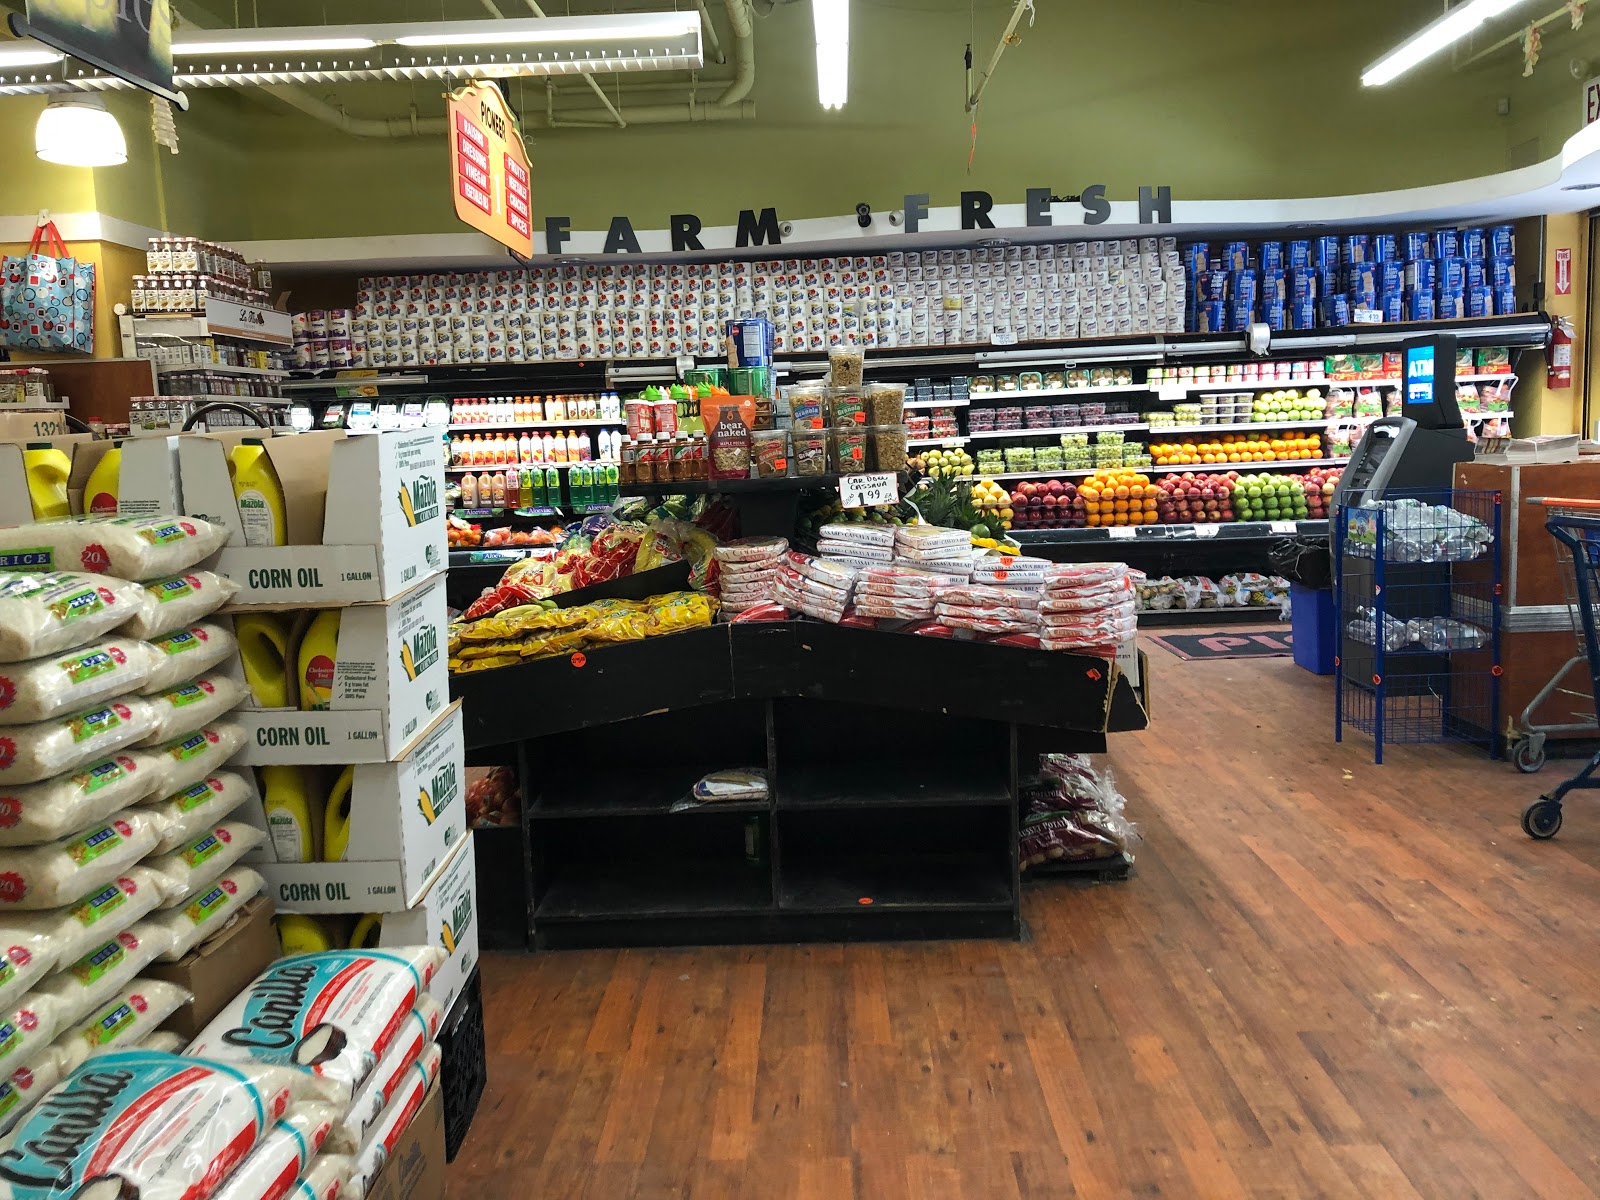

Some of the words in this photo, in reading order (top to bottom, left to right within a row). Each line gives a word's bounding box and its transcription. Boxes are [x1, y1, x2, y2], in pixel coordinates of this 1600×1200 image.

[480, 101, 506, 142] PIONEER
[463, 118, 484, 148] RAISINS
[462, 142, 487, 171] DRESSING
[464, 161, 487, 189] VINEGAR
[507, 156, 526, 183] FRUITS
[494, 173, 502, 215] 1
[510, 212, 528, 235] SPICES
[545, 207, 782, 255] FARM
[904, 184, 1172, 233] FRESH
[1557, 252, 1569, 260] FIRE
[1408, 358, 1434, 379] ATM
[794, 405, 820, 418] Granola
[836, 404, 861, 417] Granola
[717, 429, 747, 438] naked
[719, 421, 743, 430] bear
[758, 449, 783, 462] Granola
[240, 497, 265, 509] Mazola
[412, 474, 438, 512] Mazola
[84, 550, 101, 564] 20
[925, 560, 951, 568] CASSAVA
[951, 561, 972, 569] BREAD
[249, 568, 293, 589] CORN
[297, 567, 324, 588] OIL
[346, 571, 372, 581] GALLON
[413, 623, 438, 661] Mazola
[308, 666, 335, 674] Cholestero
[256, 727, 300, 747] CORN
[304, 726, 330, 746] OIL
[352, 731, 378, 740] GALLON
[431, 761, 457, 802] Mazola
[85, 828, 115, 847] RICE
[194, 836, 217, 852] RICE
[90, 886, 120, 907] RICE
[279, 882, 321, 902] CORN
[325, 882, 351, 901] OIL
[372, 886, 397, 895] GALLON
[220, 962, 319, 1049] Canilla
[0, 1069, 136, 1191] Canilla
